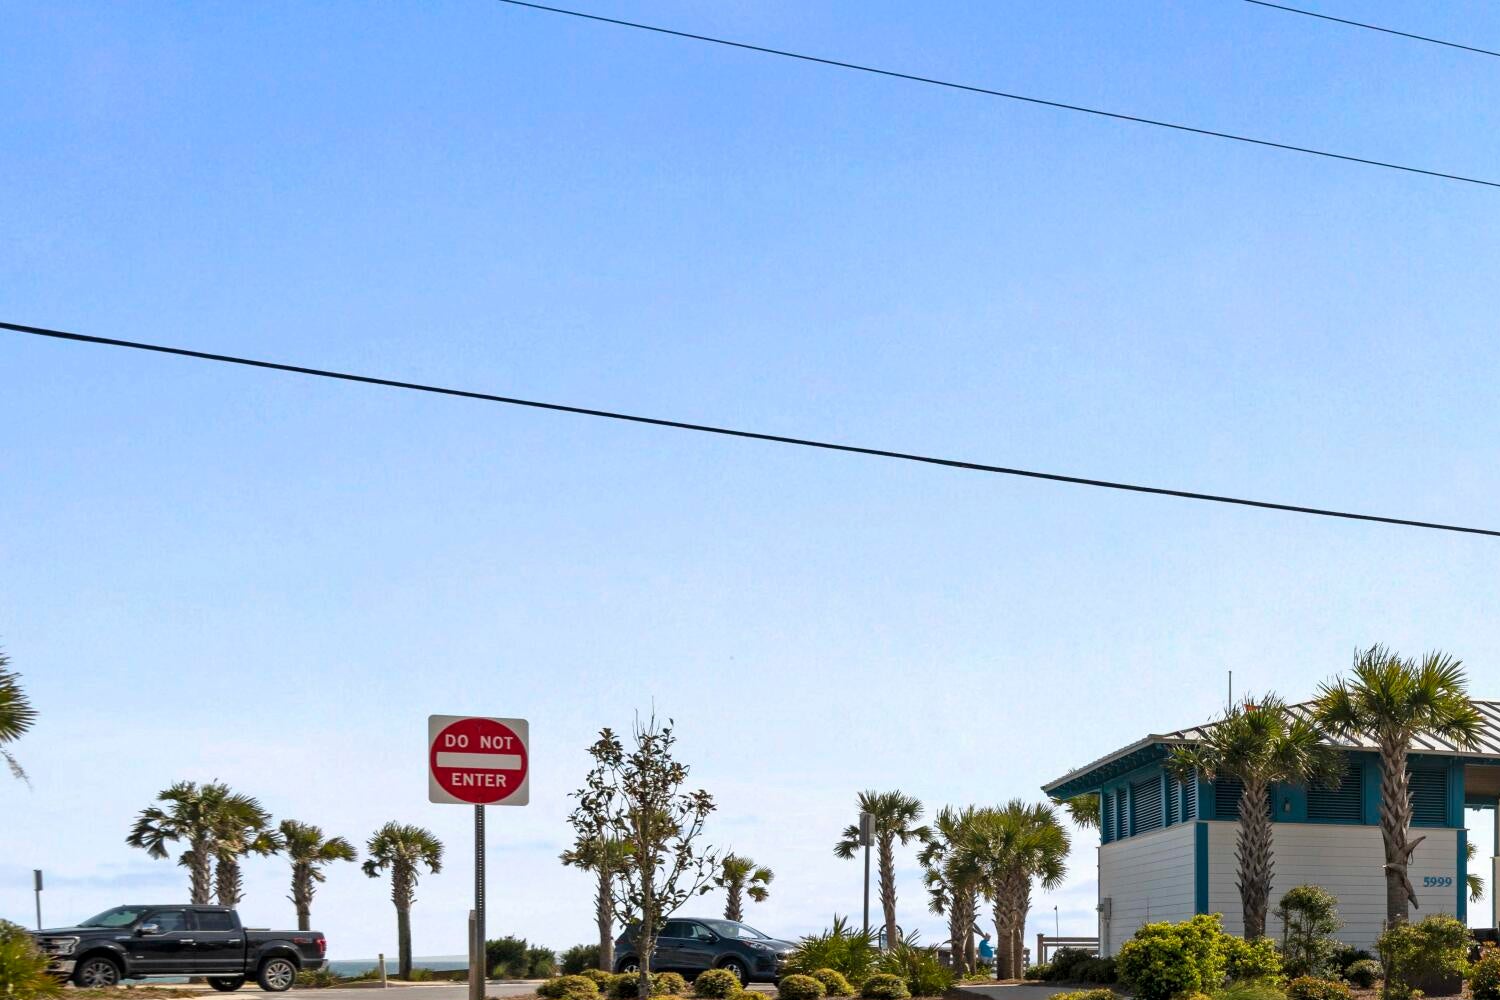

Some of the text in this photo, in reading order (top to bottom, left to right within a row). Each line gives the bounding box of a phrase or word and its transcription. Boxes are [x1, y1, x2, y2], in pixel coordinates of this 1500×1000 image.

[445, 734, 513, 749] DO NOT
[451, 772, 507, 787] ENTER
[1423, 876, 1453, 888] 5999
